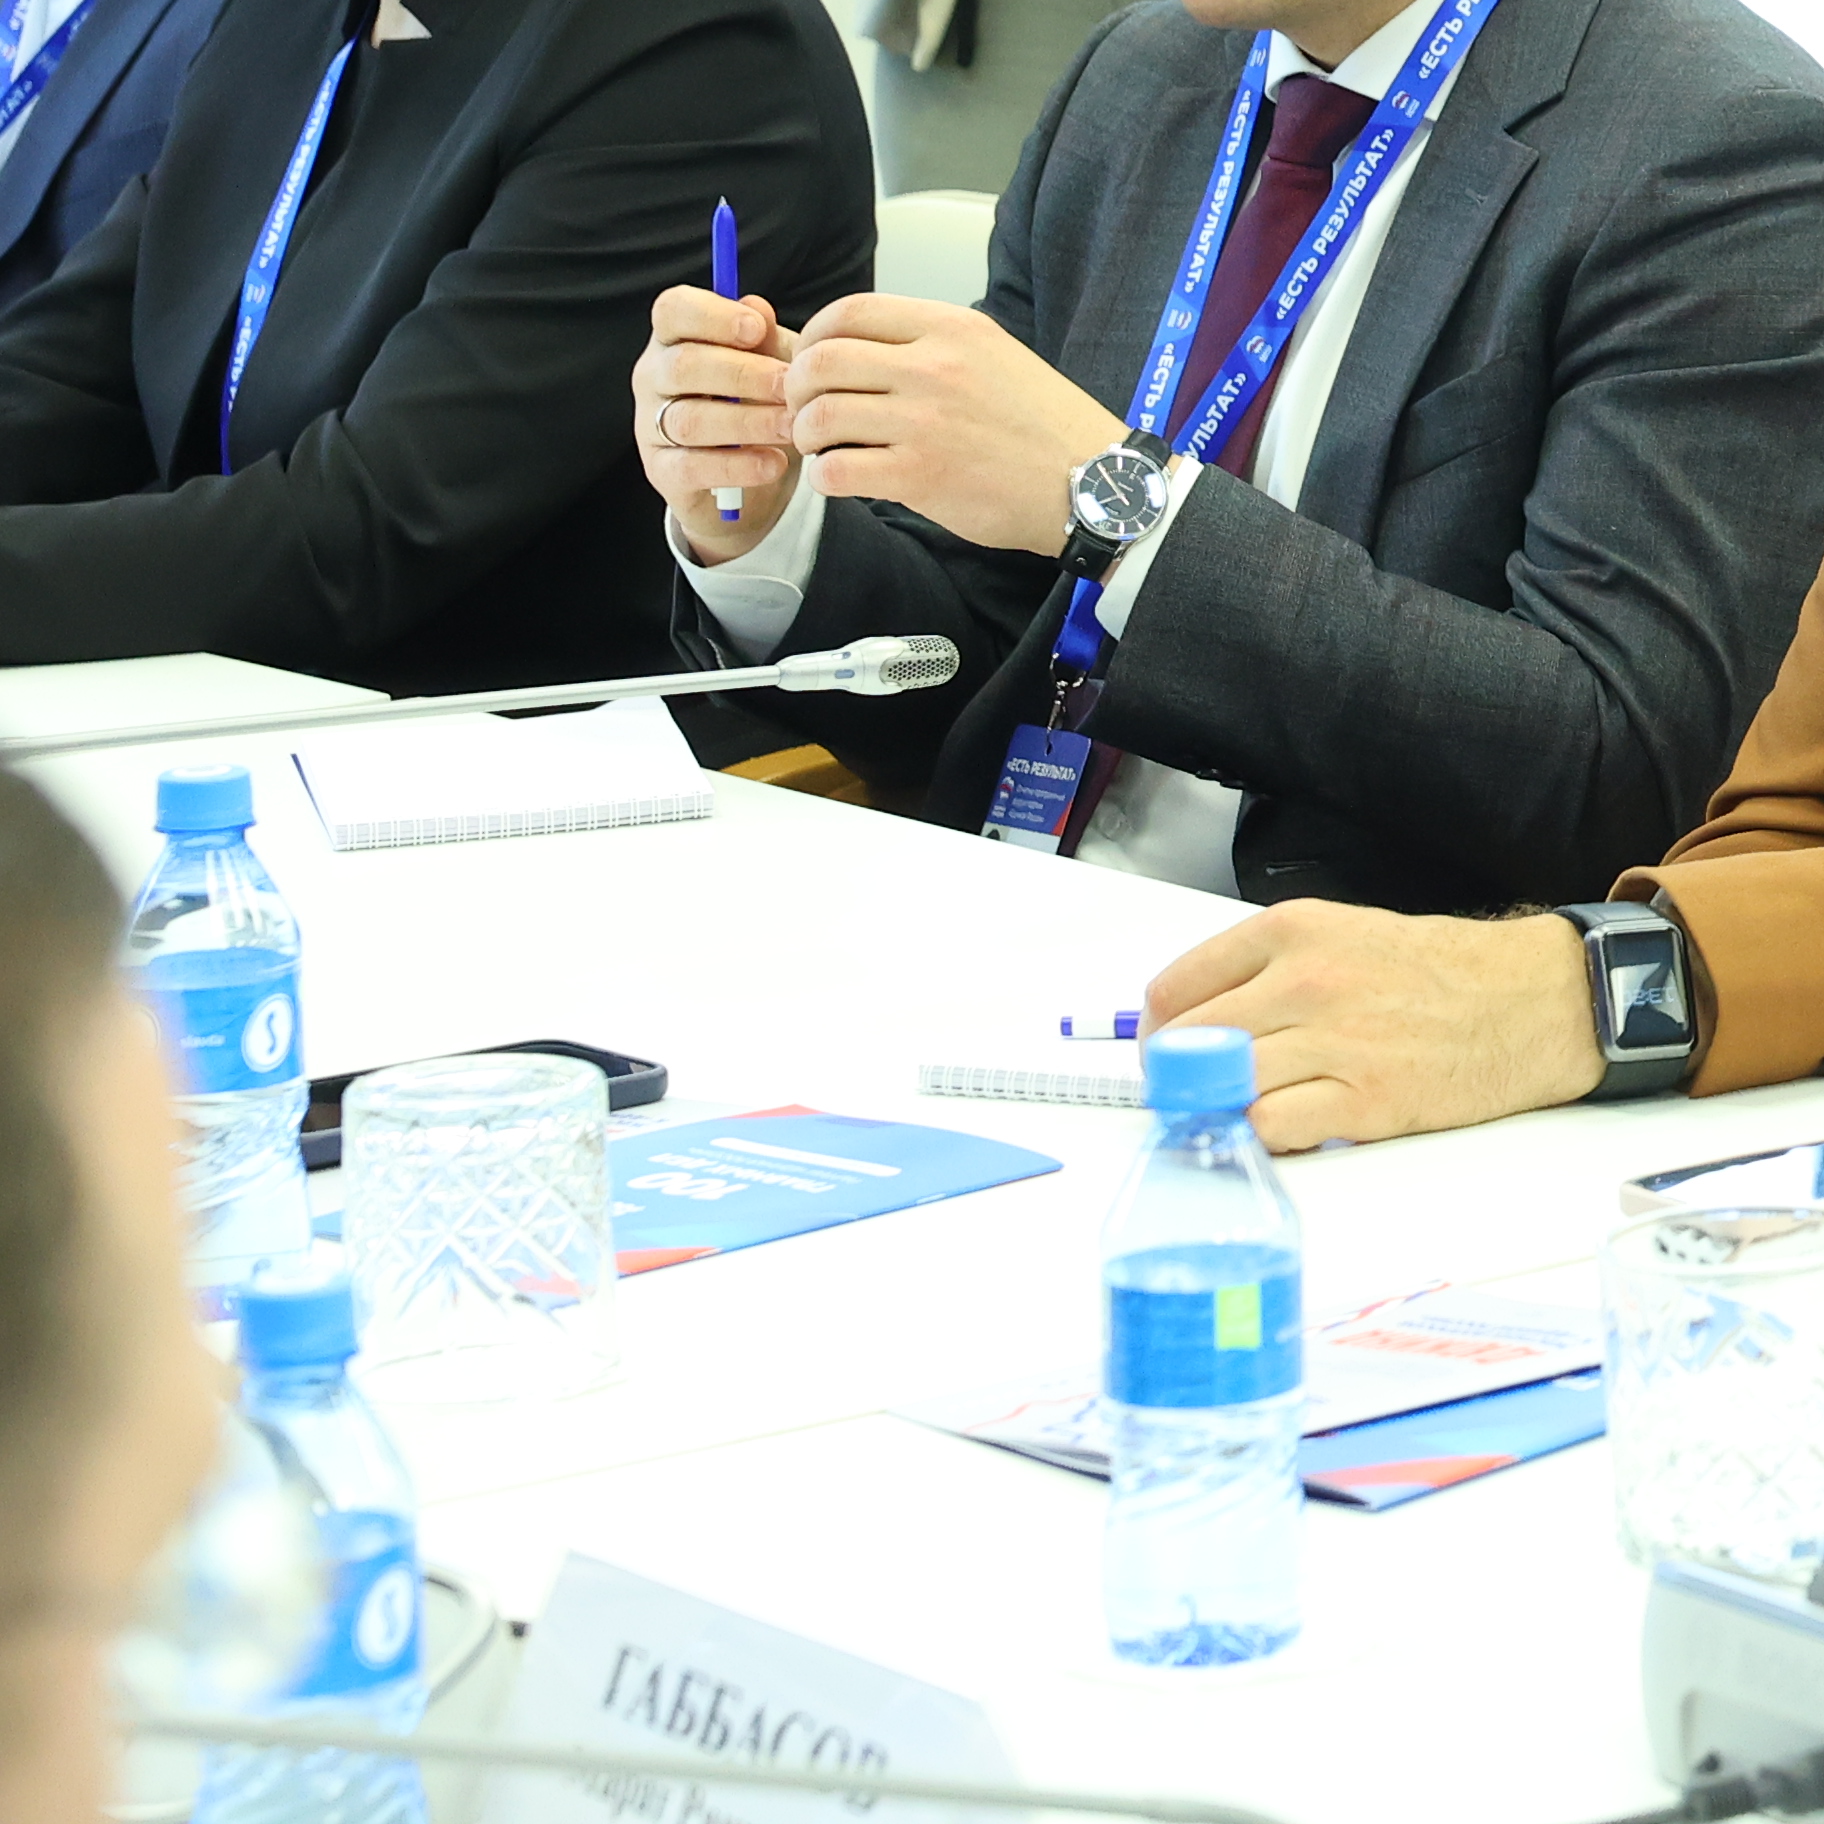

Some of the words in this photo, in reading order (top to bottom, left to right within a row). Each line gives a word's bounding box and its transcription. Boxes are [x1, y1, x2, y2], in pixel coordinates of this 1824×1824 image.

[1418, 17, 1463, 80] «ЕСТЬ
[1226, 89, 1252, 156] «ЕСТЬ
[1184, 160, 1235, 294] РЕЗУЛЬТАТ»
[1275, 254, 1320, 322] «ЕСТЬ
[1315, 128, 1394, 256] РЕЗУЛЬТАТ»
[1144, 342, 1175, 410] «ЕСТЬ
[1182, 372, 1247, 460] УЛЬТАТ»
